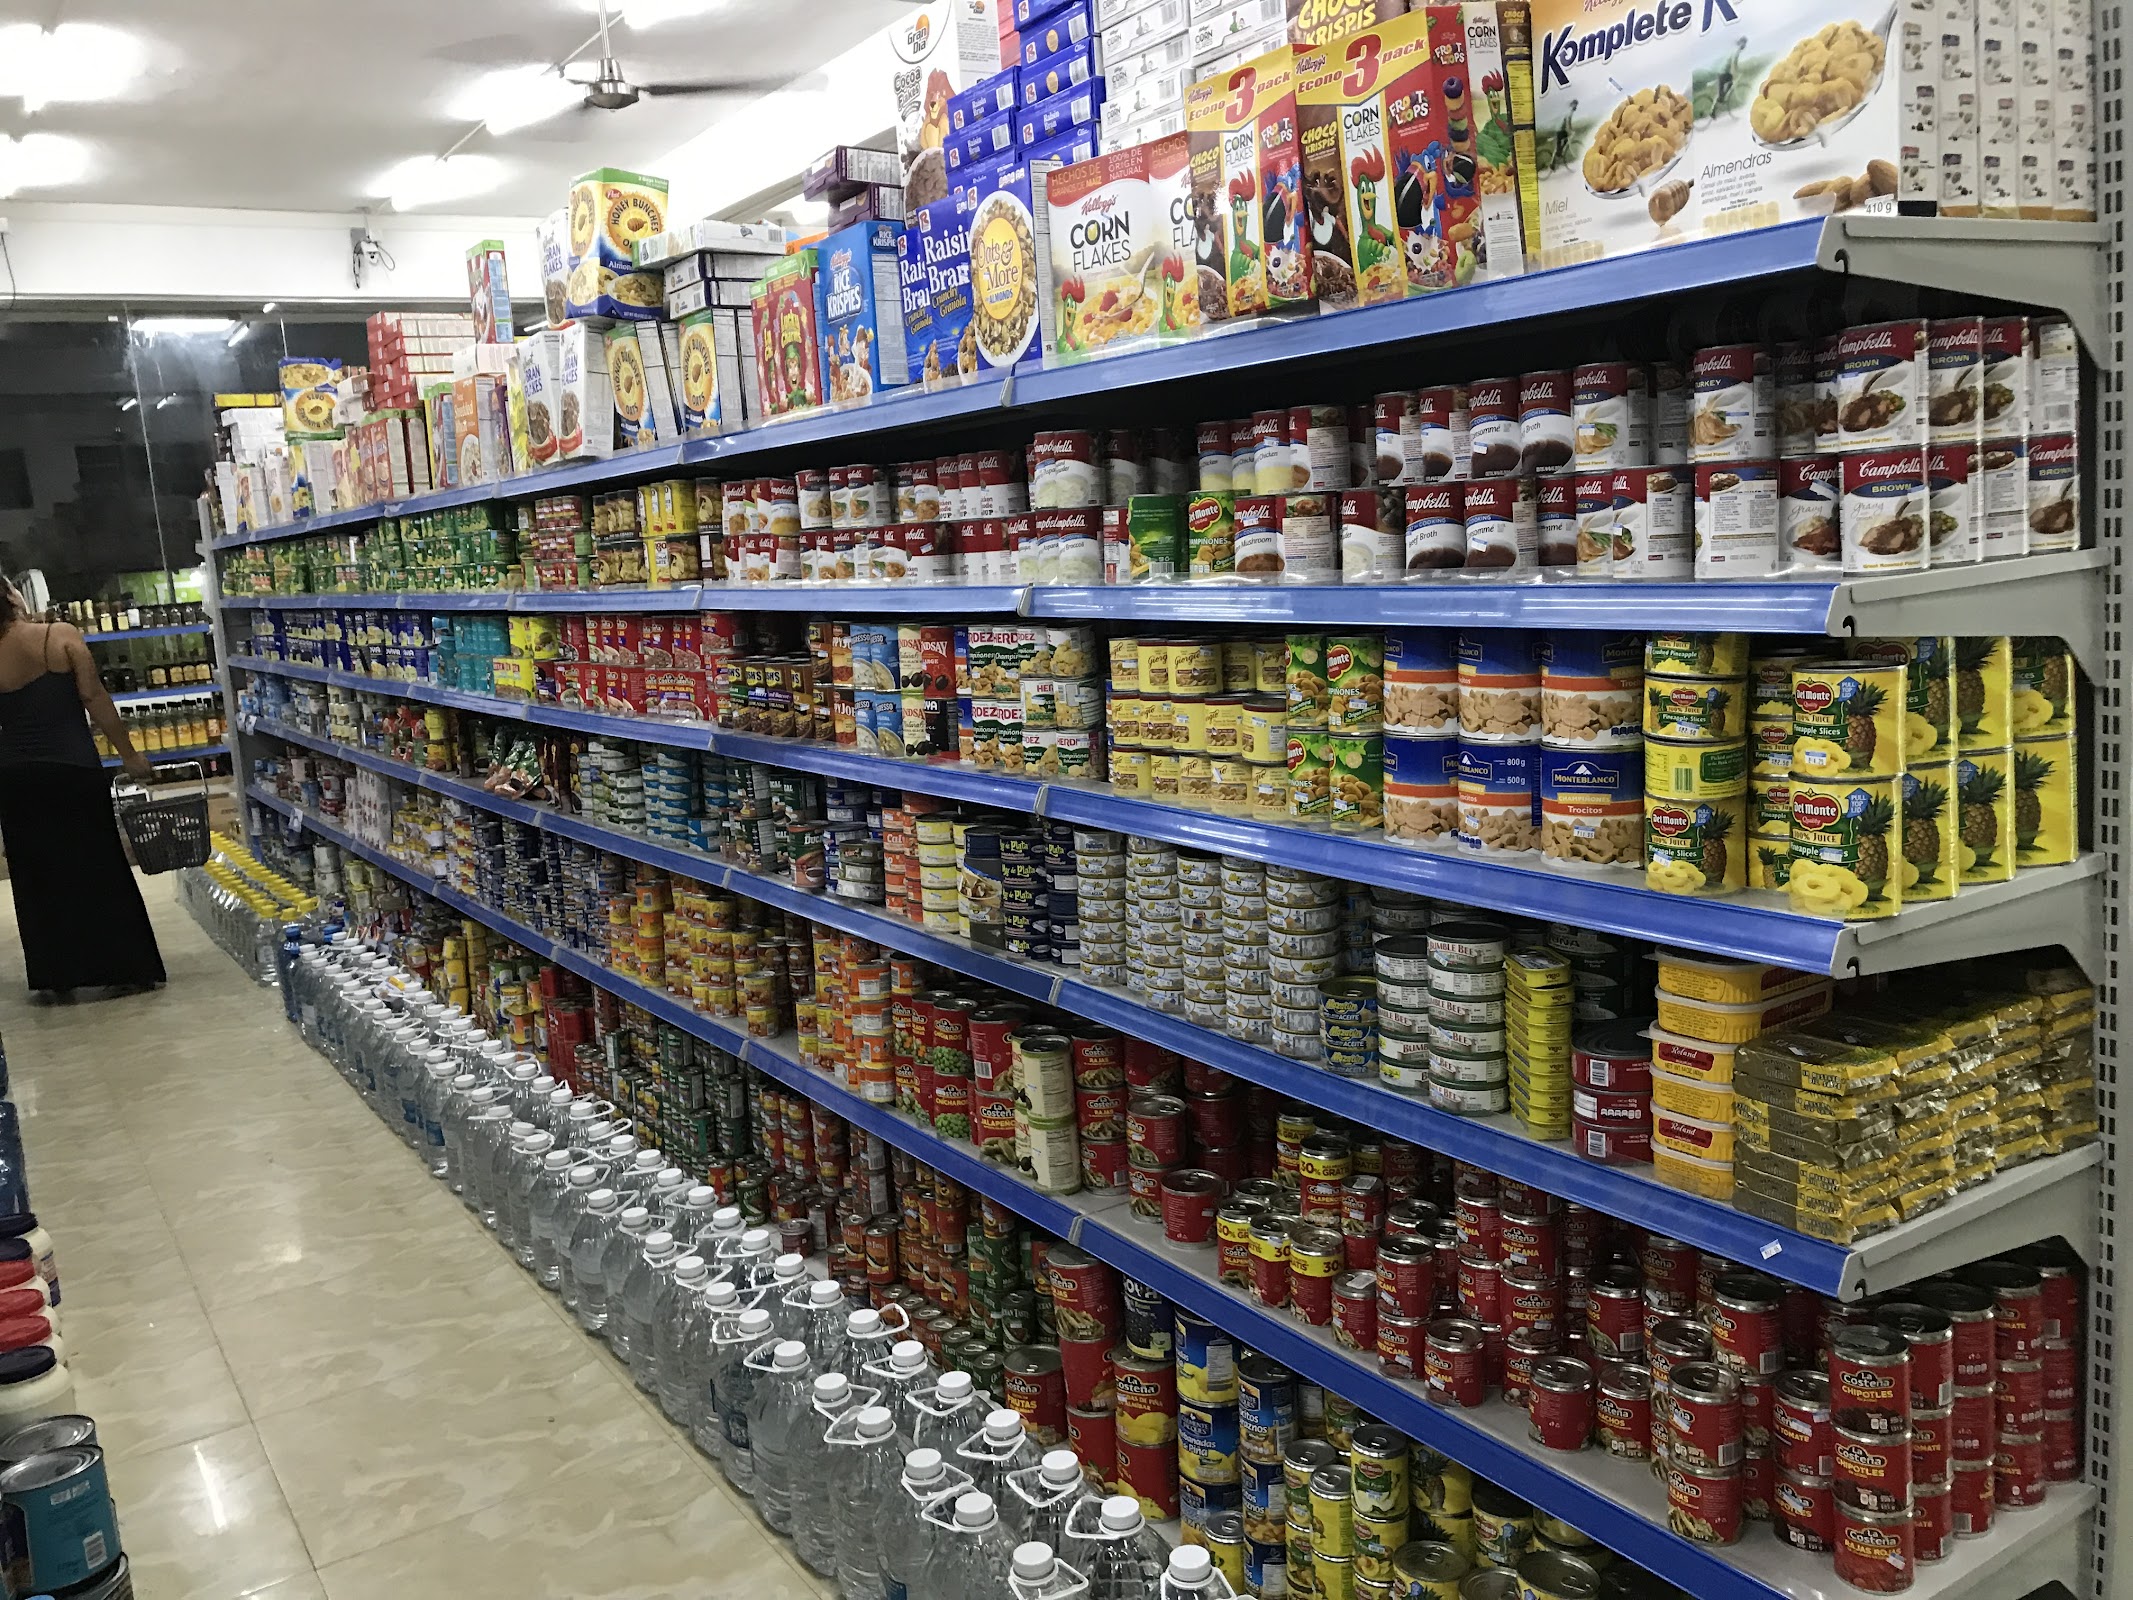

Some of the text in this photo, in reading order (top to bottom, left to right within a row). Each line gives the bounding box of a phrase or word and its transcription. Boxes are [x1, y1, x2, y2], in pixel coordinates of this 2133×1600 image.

[1306, 3, 1377, 46] KRISPIS
[907, 26, 927, 45] Gran
[1195, 30, 1213, 44] CORN
[1467, 26, 1496, 39] CORN
[1469, 38, 1498, 49] FLAKES
[1541, 0, 1692, 94] Komplete
[1381, 38, 1426, 64] pack
[1296, 53, 1327, 74] Kellogg's
[1342, 33, 1382, 98] 3
[894, 67, 922, 92] Cocoa
[1257, 71, 1291, 94] pack
[1298, 70, 1342, 94] Econo
[1225, 67, 1257, 124] 3
[1189, 100, 1225, 121] Econo
[1343, 104, 1380, 130] CORN
[1394, 102, 1429, 125] LOOPS
[1301, 121, 1337, 144] CHOCO
[1345, 122, 1381, 145] FLAKES
[1152, 137, 1187, 155] HECHOS
[1224, 130, 1254, 154] CORN
[1305, 136, 1336, 154] KRISPIS
[1108, 147, 1142, 163] 100% DE
[1190, 146, 1219, 168] CHOCO
[1225, 146, 1253, 166] FLAKES
[1109, 156, 1143, 172] ORIGEN
[1193, 160, 1217, 176] KRISPIS
[1702, 152, 1772, 180] Almendras
[1052, 162, 1101, 186] HECHOS DE
[1109, 166, 1143, 180] NATURAL
[607, 190, 621, 199] Post
[1081, 194, 1117, 215] Kellogg's
[1545, 199, 1569, 216] Miel
[1866, 202, 1882, 214] 410
[611, 198, 629, 226] HONEY
[632, 198, 659, 233] BUNCHES
[879, 230, 893, 239] RICE
[1070, 211, 1130, 249] CORN
[976, 237, 1014, 269] Oats &
[1073, 239, 1132, 272] FLAKES
[834, 268, 851, 291] RICE
[986, 265, 1019, 291] More
[827, 286, 861, 320] KRISPIES
[1844, 359, 1880, 370] BROWN
[1931, 354, 1970, 365] BROWN
[1526, 422, 1541, 435] Broth
[1860, 457, 1921, 477] Campbell's
[1871, 483, 1912, 493] BROWN
[1194, 506, 1219, 519] Monte
[1419, 518, 1446, 528] COOKING
[1240, 537, 1272, 547] Mushroom
[1420, 531, 1437, 542] Broth
[1670, 649, 1698, 658] Pineapple
[1796, 690, 1830, 701] Del Monte
[972, 706, 998, 718] RDEZ
[1811, 714, 1831, 723] JUICE
[1818, 726, 1841, 735] Slices
[1458, 765, 1489, 775] NTEBLANCO
[1554, 774, 1615, 784] MONTEBLANCO
[1568, 806, 1603, 814] Trocitos
[1761, 811, 1787, 819] Pineapple
[1794, 802, 1836, 816] Del Monte
[1653, 814, 1687, 826] Del Monte
[1802, 816, 1821, 825] Quality
[1669, 837, 1687, 846] JUICE
[1813, 833, 1837, 843] JUICE
[1676, 850, 1698, 858] Slices
[1017, 865, 1036, 877] Plata
[1429, 940, 1477, 956] BUMBLE BEE
[1447, 1003, 1465, 1014] BEE
[1452, 1034, 1469, 1046] BEE
[1403, 1044, 1428, 1053] BUMB
[1670, 1046, 1698, 1059] Roland
[1670, 1123, 1697, 1136] Roland
[1301, 1162, 1321, 1176] 30%
[1503, 1230, 1537, 1242] Costeña
[1501, 1242, 1539, 1257] MEXICANA
[1516, 1298, 1550, 1307] Costeña
[1513, 1311, 1554, 1321] MEXICANA
[1116, 1381, 1155, 1394] Costeña
[1127, 1376, 1138, 1385] La
[1843, 1375, 1890, 1387] Costeña
[1842, 1386, 1893, 1398] CHIPOTLES
[1008, 1395, 1037, 1409] FRUTAS
[1780, 1428, 1810, 1442] TOMATE
[1837, 1447, 1882, 1466] Costeña
[1836, 1457, 1885, 1477] CHIPOTLES
[1850, 1529, 1897, 1545] Costeña
[1845, 1540, 1872, 1555] RAJAS
